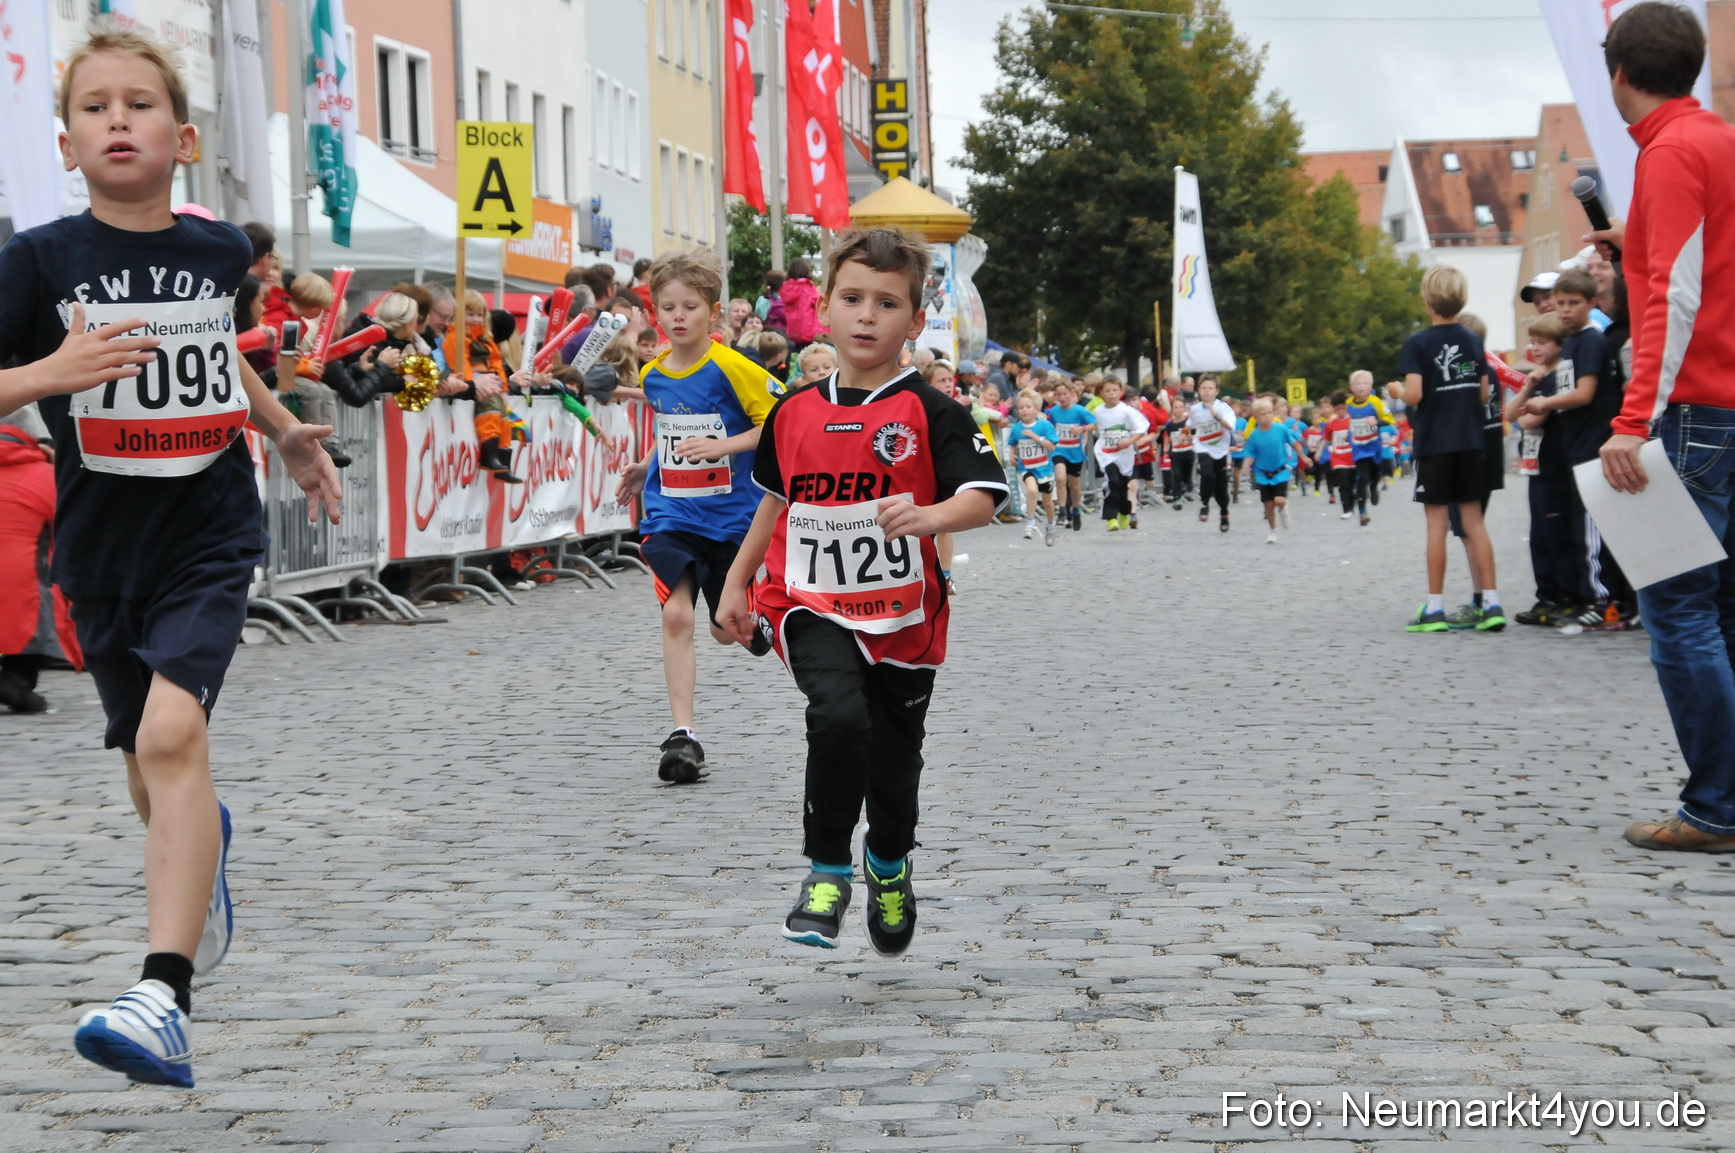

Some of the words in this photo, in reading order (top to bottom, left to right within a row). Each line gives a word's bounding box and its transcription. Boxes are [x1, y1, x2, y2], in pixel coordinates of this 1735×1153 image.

[466, 125, 524, 147] Block
[472, 156, 516, 213] A
[149, 266, 228, 303] YOR
[144, 318, 220, 336] Neumarkt
[114, 425, 223, 452] Johannes
[672, 423, 710, 431] Neumarkt
[662, 434, 721, 466] 75
[789, 515, 823, 532] PARTL
[799, 536, 911, 586] 7129
[832, 599, 886, 618] Aaron
